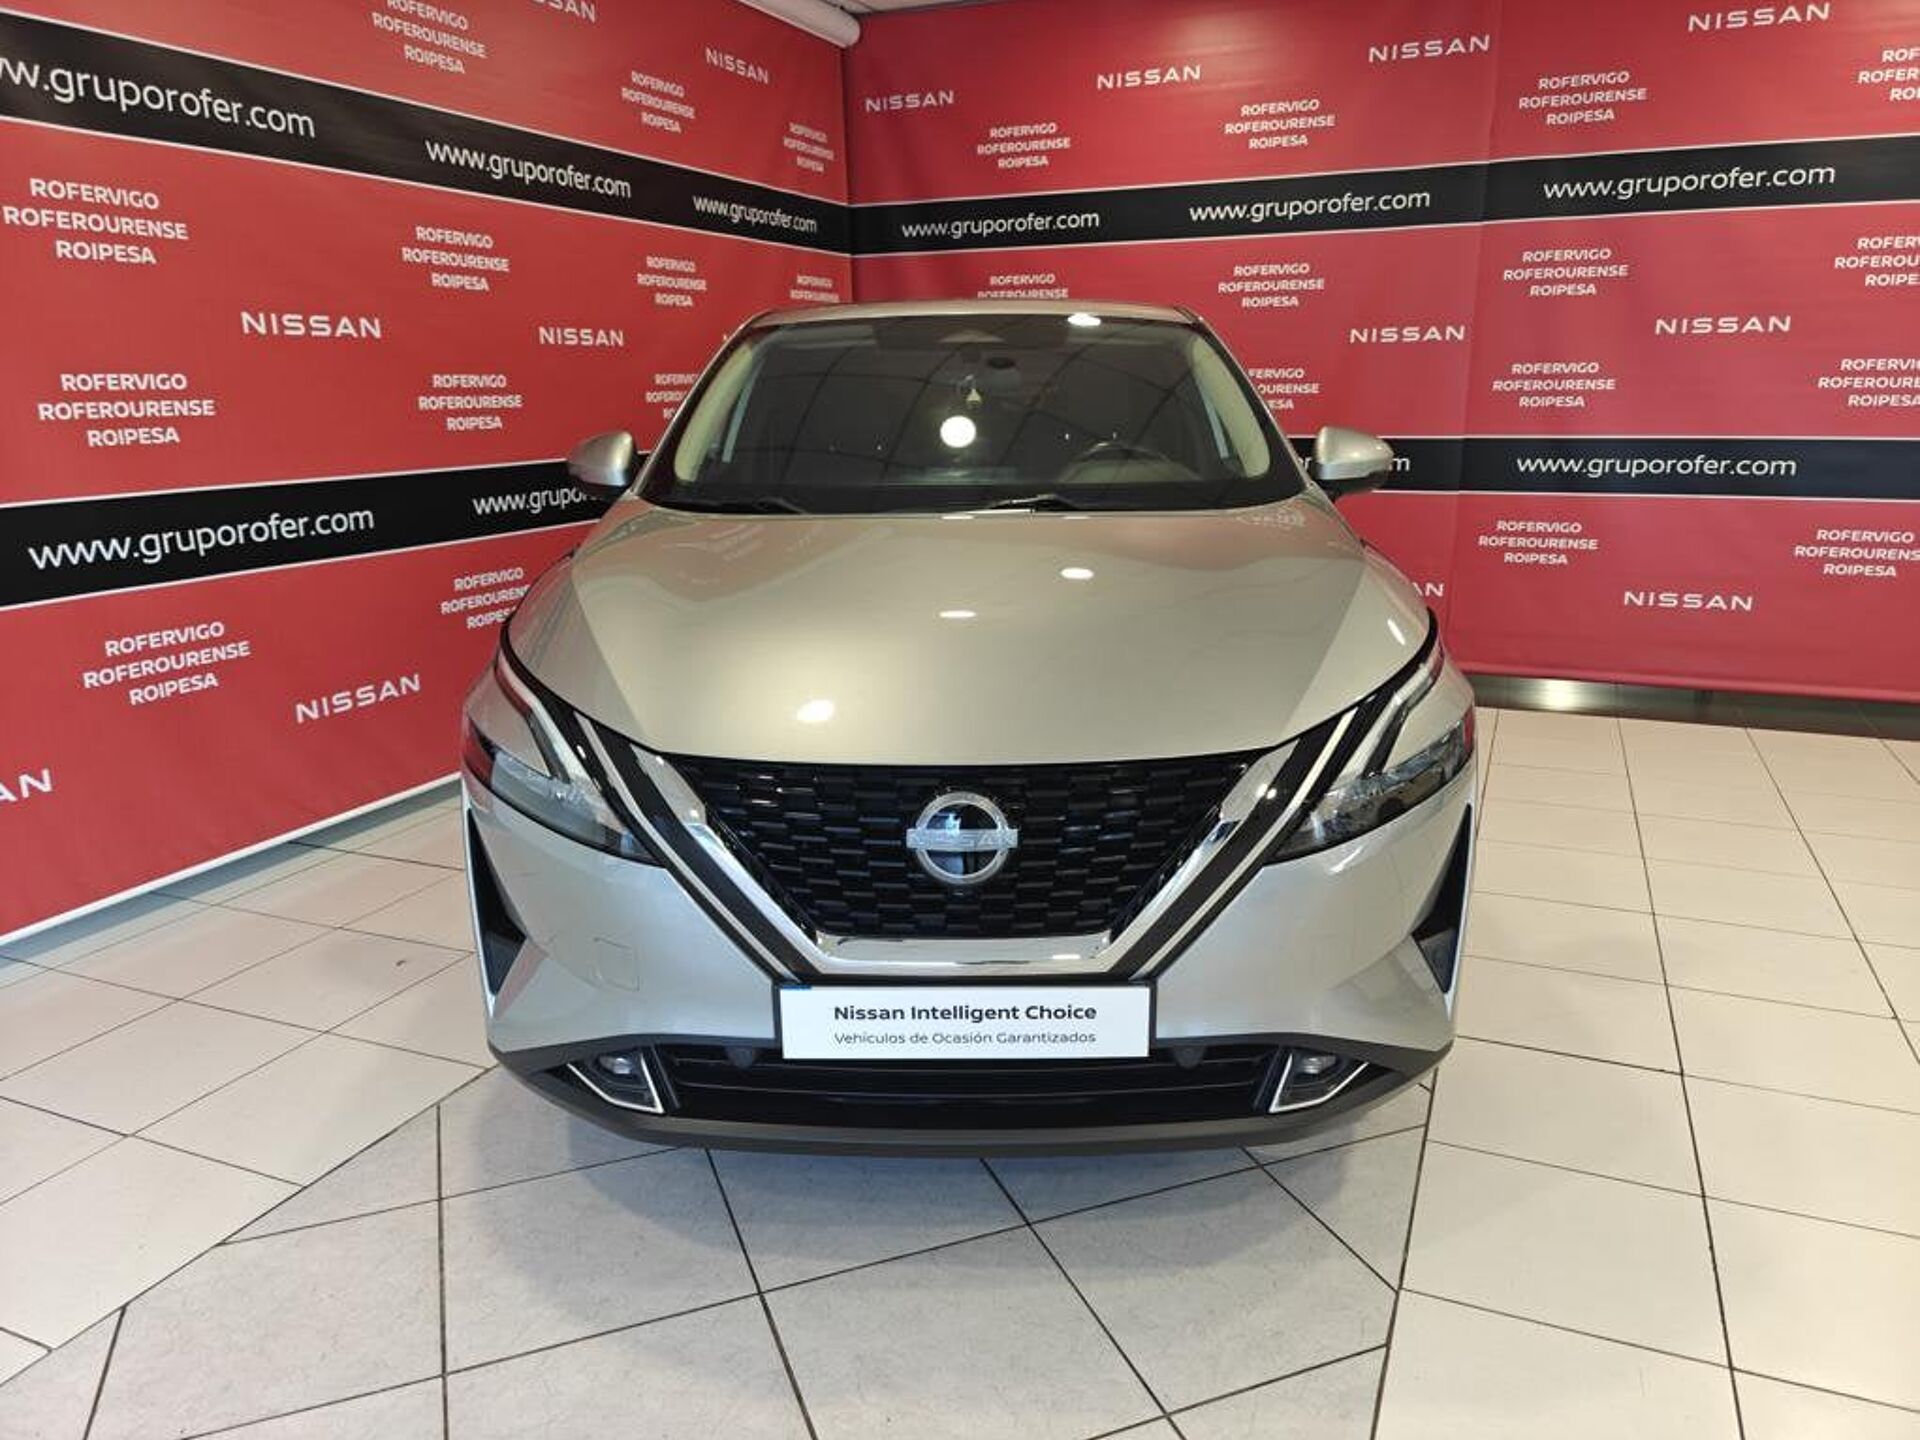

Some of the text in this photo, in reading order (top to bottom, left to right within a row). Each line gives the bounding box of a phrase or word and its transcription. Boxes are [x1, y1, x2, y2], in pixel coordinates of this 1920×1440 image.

[1687, 3, 1830, 32] NISSAN
[371, 12, 487, 58] ROFEROURENSE
[1368, 34, 1491, 62] NISSAN
[403, 44, 465, 74] ROIPESA
[705, 48, 770, 85] NISSAN
[1096, 65, 1202, 90] NISSAN
[1538, 71, 1631, 91] ROFERVIGO
[864, 90, 955, 112] NISSAN
[1240, 99, 1320, 117] ROFERVIGO
[1518, 87, 1648, 110] ROFEROURENSE
[1224, 114, 1336, 135] ROFEROURENSE
[1546, 109, 1615, 126] ROIPESA
[989, 122, 1058, 138] ROFERVIGO
[976, 136, 1072, 155] ROFEROURENSE
[1249, 134, 1309, 151] ROIPESA
[425, 140, 632, 198] www.gruporofer.com
[997, 155, 1049, 169] ROIPESA
[1543, 164, 1837, 200] www.gruporofer.com
[30, 178, 160, 210] ROFERVIGO
[693, 195, 818, 234] www.gruporofer.com
[1189, 189, 1431, 223] www.gruporofer.com
[3, 207, 189, 241] ROFEROURENSE
[902, 211, 1100, 239] www.gruporofer.com
[415, 226, 494, 250] ROFERVIGO
[55, 241, 157, 265] ROIPESA
[402, 247, 510, 273] ROFEROURENSE
[1521, 248, 1612, 263] ROFERVIGO
[1233, 263, 1311, 277] ROFERVIGO
[1502, 264, 1629, 282] ROFEROURENSE
[431, 273, 490, 293] ROIPESA
[1217, 279, 1326, 294] ROFEROURENSE
[1529, 283, 1597, 297] ROIPESA
[1241, 297, 1300, 308] ROIPESA
[240, 311, 382, 339] NISSAN
[1349, 327, 1466, 344] NISSAN
[1654, 315, 1792, 336] NISSAN
[539, 327, 625, 347] NISSAN
[1511, 362, 1600, 375] ROFERVIGO
[60, 373, 188, 392] ROFERVIGO
[432, 375, 507, 389] ROFERVIGO
[1492, 377, 1617, 392] ROFEROURENSE
[38, 399, 216, 423] ROFEROURENSE
[418, 396, 525, 411] ROFEROURENSE
[1518, 395, 1586, 409] ROIPESA
[446, 417, 503, 432] ROIPESA
[87, 426, 180, 448] ROIPESA
[1516, 455, 1798, 478] www.gruporofer.com
[1496, 520, 1582, 534] ROFERVIGO
[1816, 529, 1915, 545] ROFERVIGO
[28, 509, 375, 570] www.gruporofer.com
[1478, 535, 1599, 551] ROFEROURENSE
[1504, 551, 1569, 566] ROIPESA
[453, 567, 525, 592] ROFERVIGO
[1823, 563, 1897, 578] ROIPESA
[1624, 590, 1753, 612] NISSAN
[105, 621, 225, 658] ROFERVIGO
[83, 640, 250, 690] ROFEROURENSE
[129, 671, 219, 706] ROIPESA
[296, 672, 422, 724] NISSAN
[833, 1004, 1098, 1023] Nissan Intelligent Choice
[909, 1031, 930, 1044] de
[932, 1030, 993, 1044] Ocasión
[996, 1030, 1098, 1044] Garantizados
